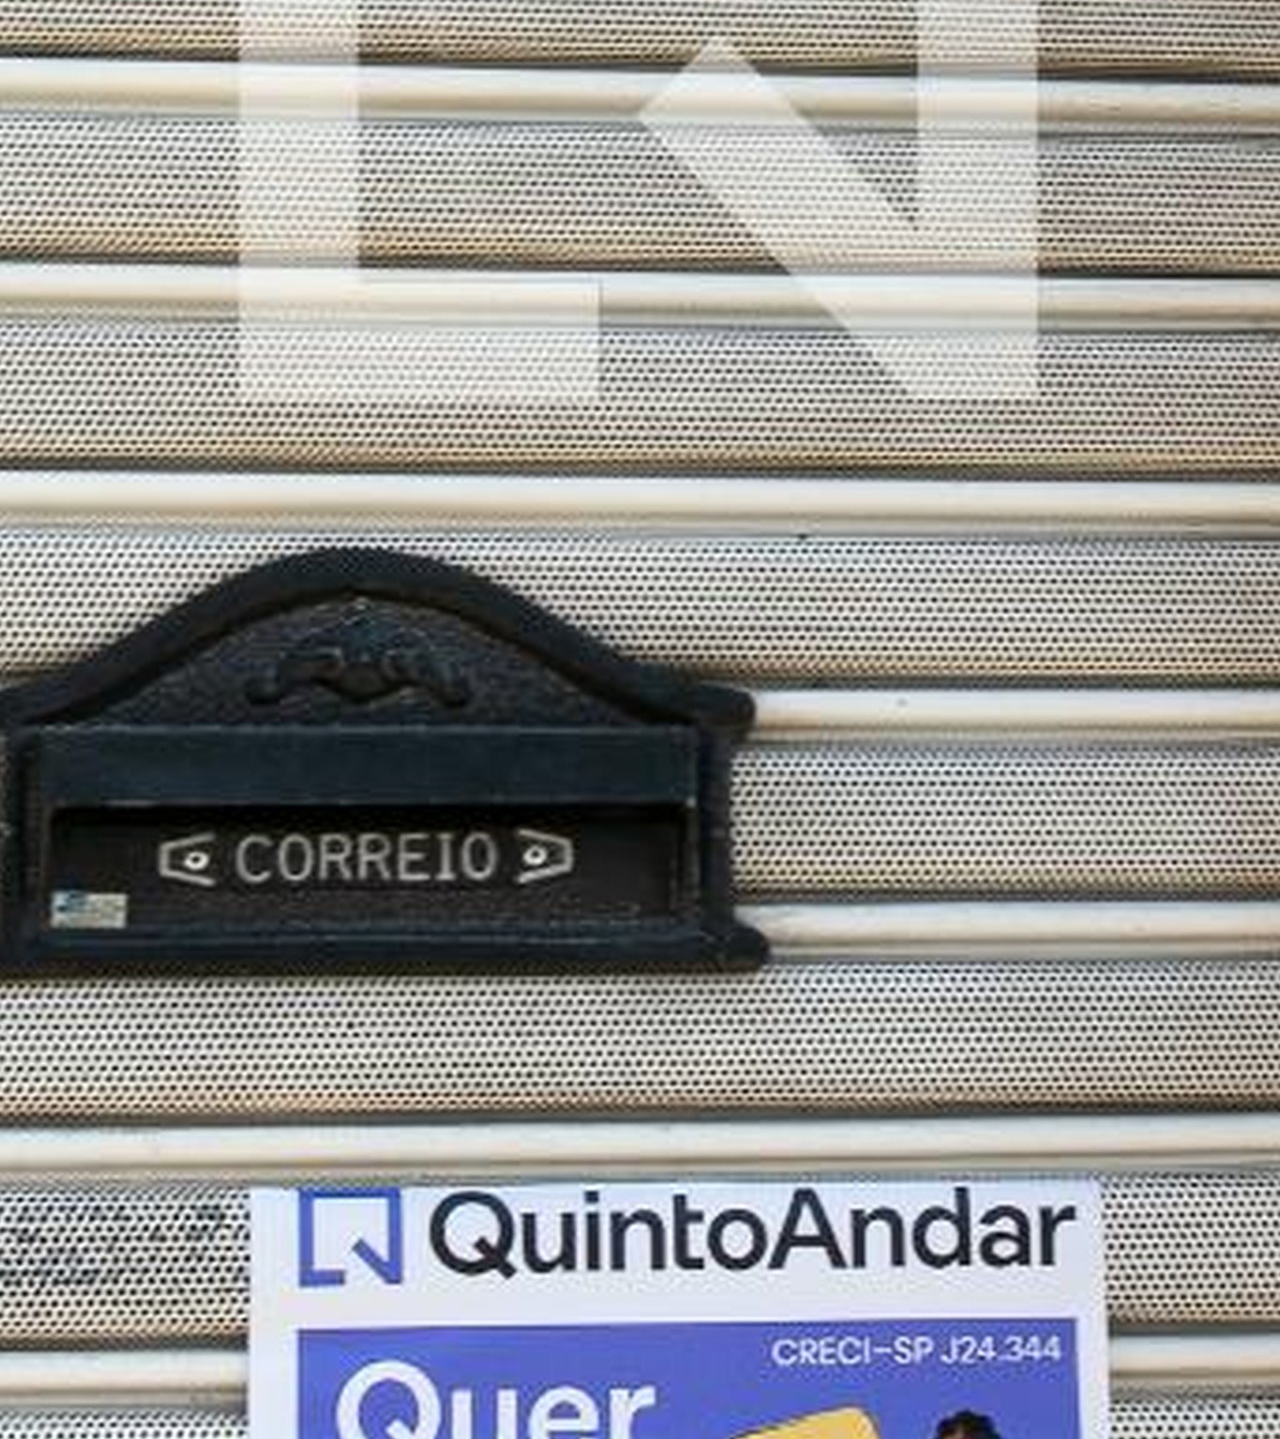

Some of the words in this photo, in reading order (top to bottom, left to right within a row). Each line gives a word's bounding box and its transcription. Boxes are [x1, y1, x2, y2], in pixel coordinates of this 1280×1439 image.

[234, 833, 499, 883] CORREIO
[428, 1188, 1076, 1279] QuintoAndar
[940, 1336, 1061, 1363] J24.344
